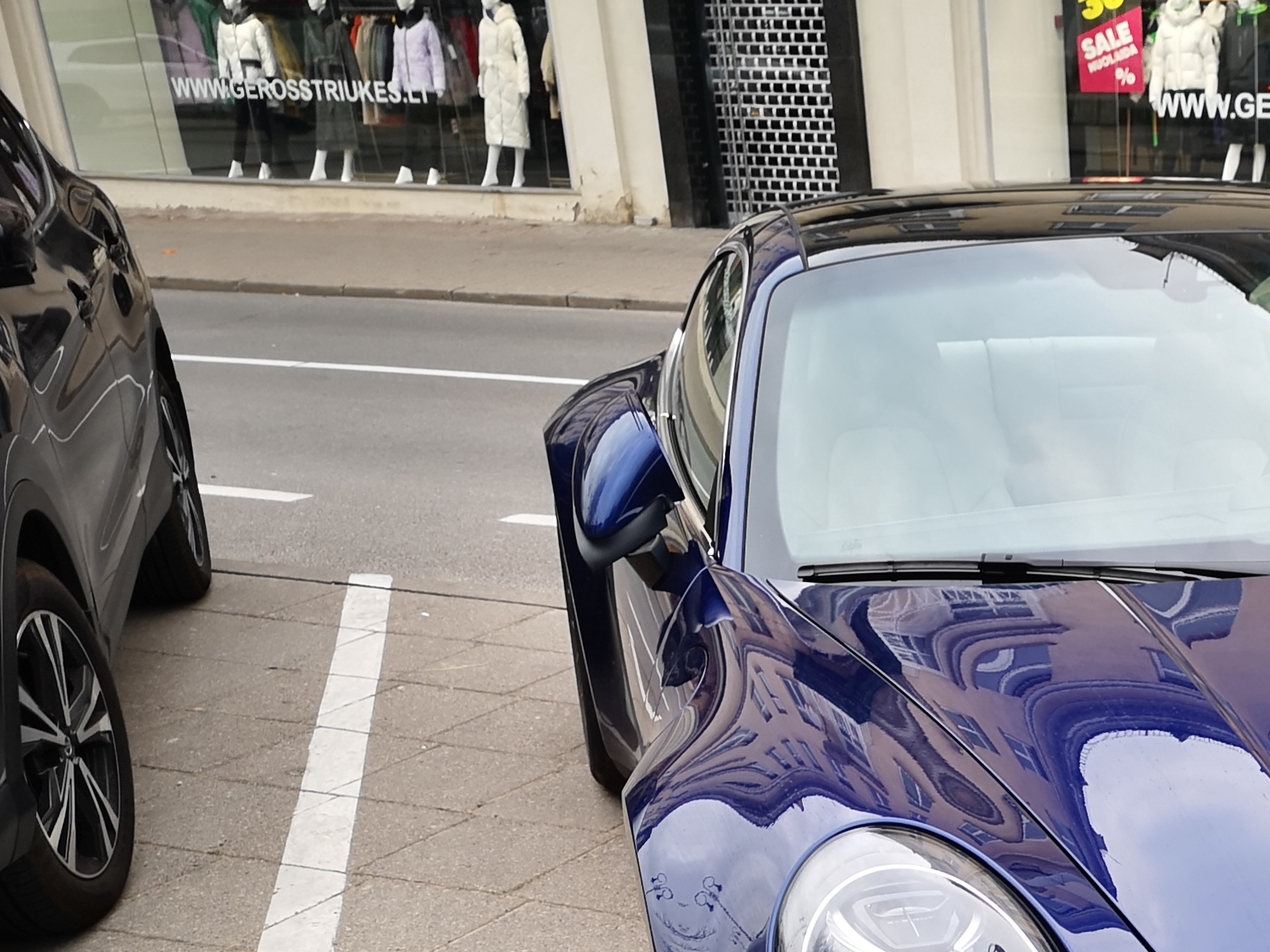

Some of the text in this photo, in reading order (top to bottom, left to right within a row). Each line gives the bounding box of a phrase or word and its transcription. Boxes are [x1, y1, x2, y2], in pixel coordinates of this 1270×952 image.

[1081, 21, 1133, 60] SALE
[1115, 67, 1136, 86] %
[171, 77, 428, 104] WWW.GEROSSTRIUKES.LT
